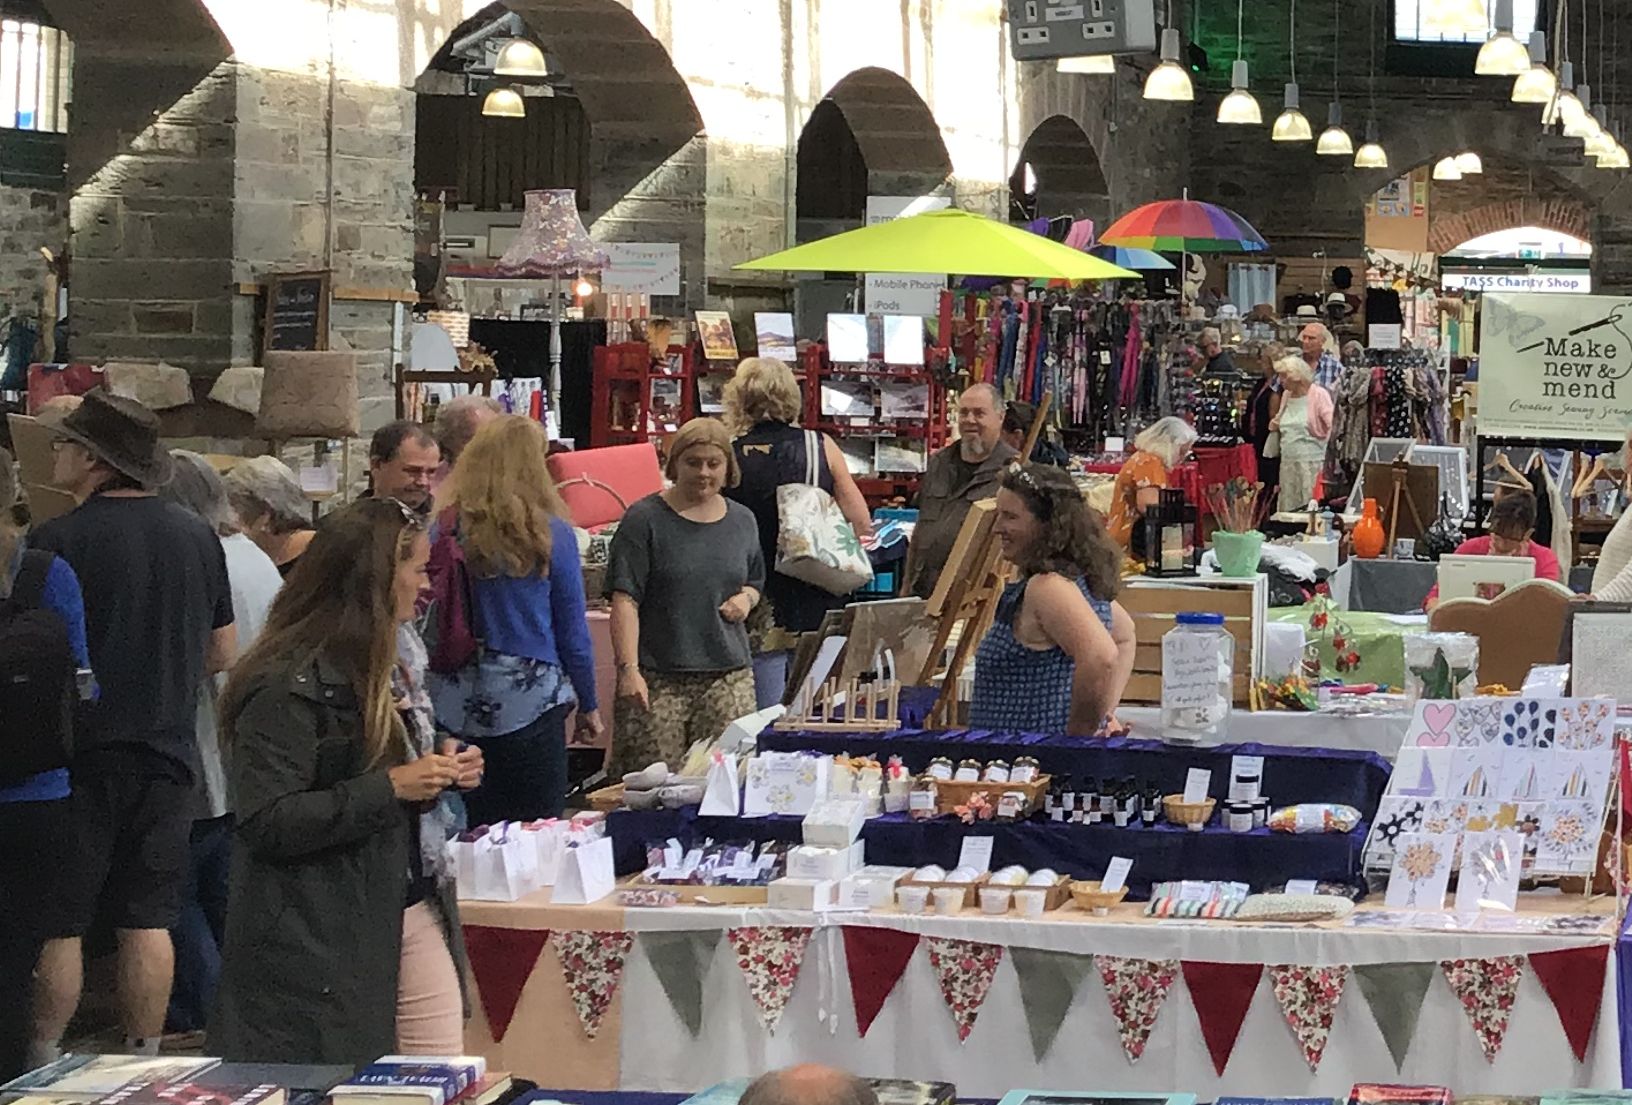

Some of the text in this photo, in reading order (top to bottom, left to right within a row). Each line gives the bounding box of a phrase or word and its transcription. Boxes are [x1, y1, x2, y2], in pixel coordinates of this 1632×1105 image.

[874, 279, 909, 290] Mobile
[1462, 276, 1579, 289] TASS Charity Shop
[874, 300, 900, 310] iPods
[1543, 337, 1617, 359] Make
[1543, 361, 1616, 379] new &
[1542, 380, 1617, 400] mend
